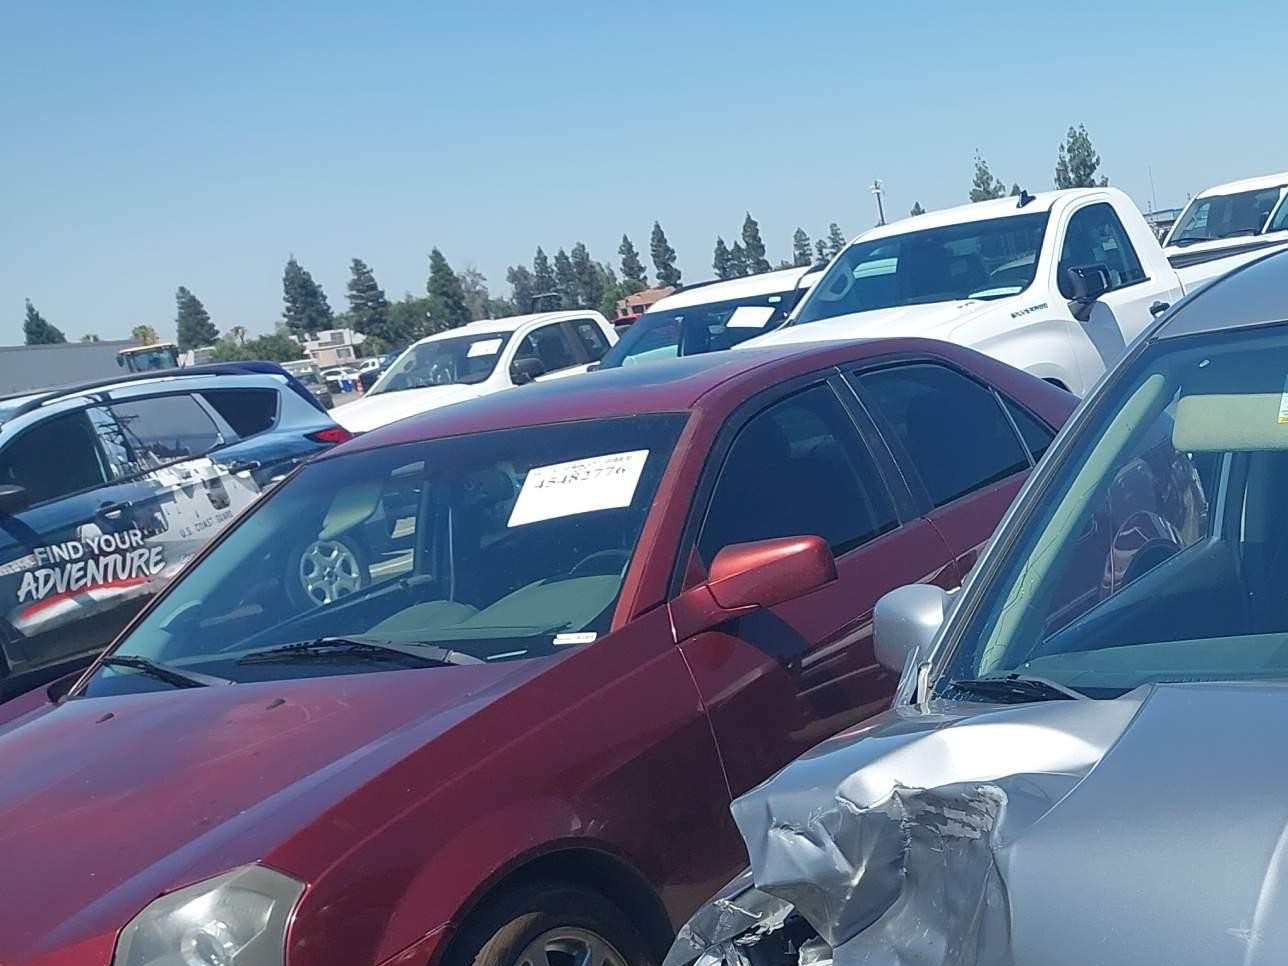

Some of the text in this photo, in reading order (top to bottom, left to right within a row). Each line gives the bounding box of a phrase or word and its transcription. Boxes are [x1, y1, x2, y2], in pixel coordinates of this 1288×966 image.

[33, 541, 84, 567] FIND
[87, 528, 145, 555] YOUR
[17, 546, 167, 602] ADVENTURE
